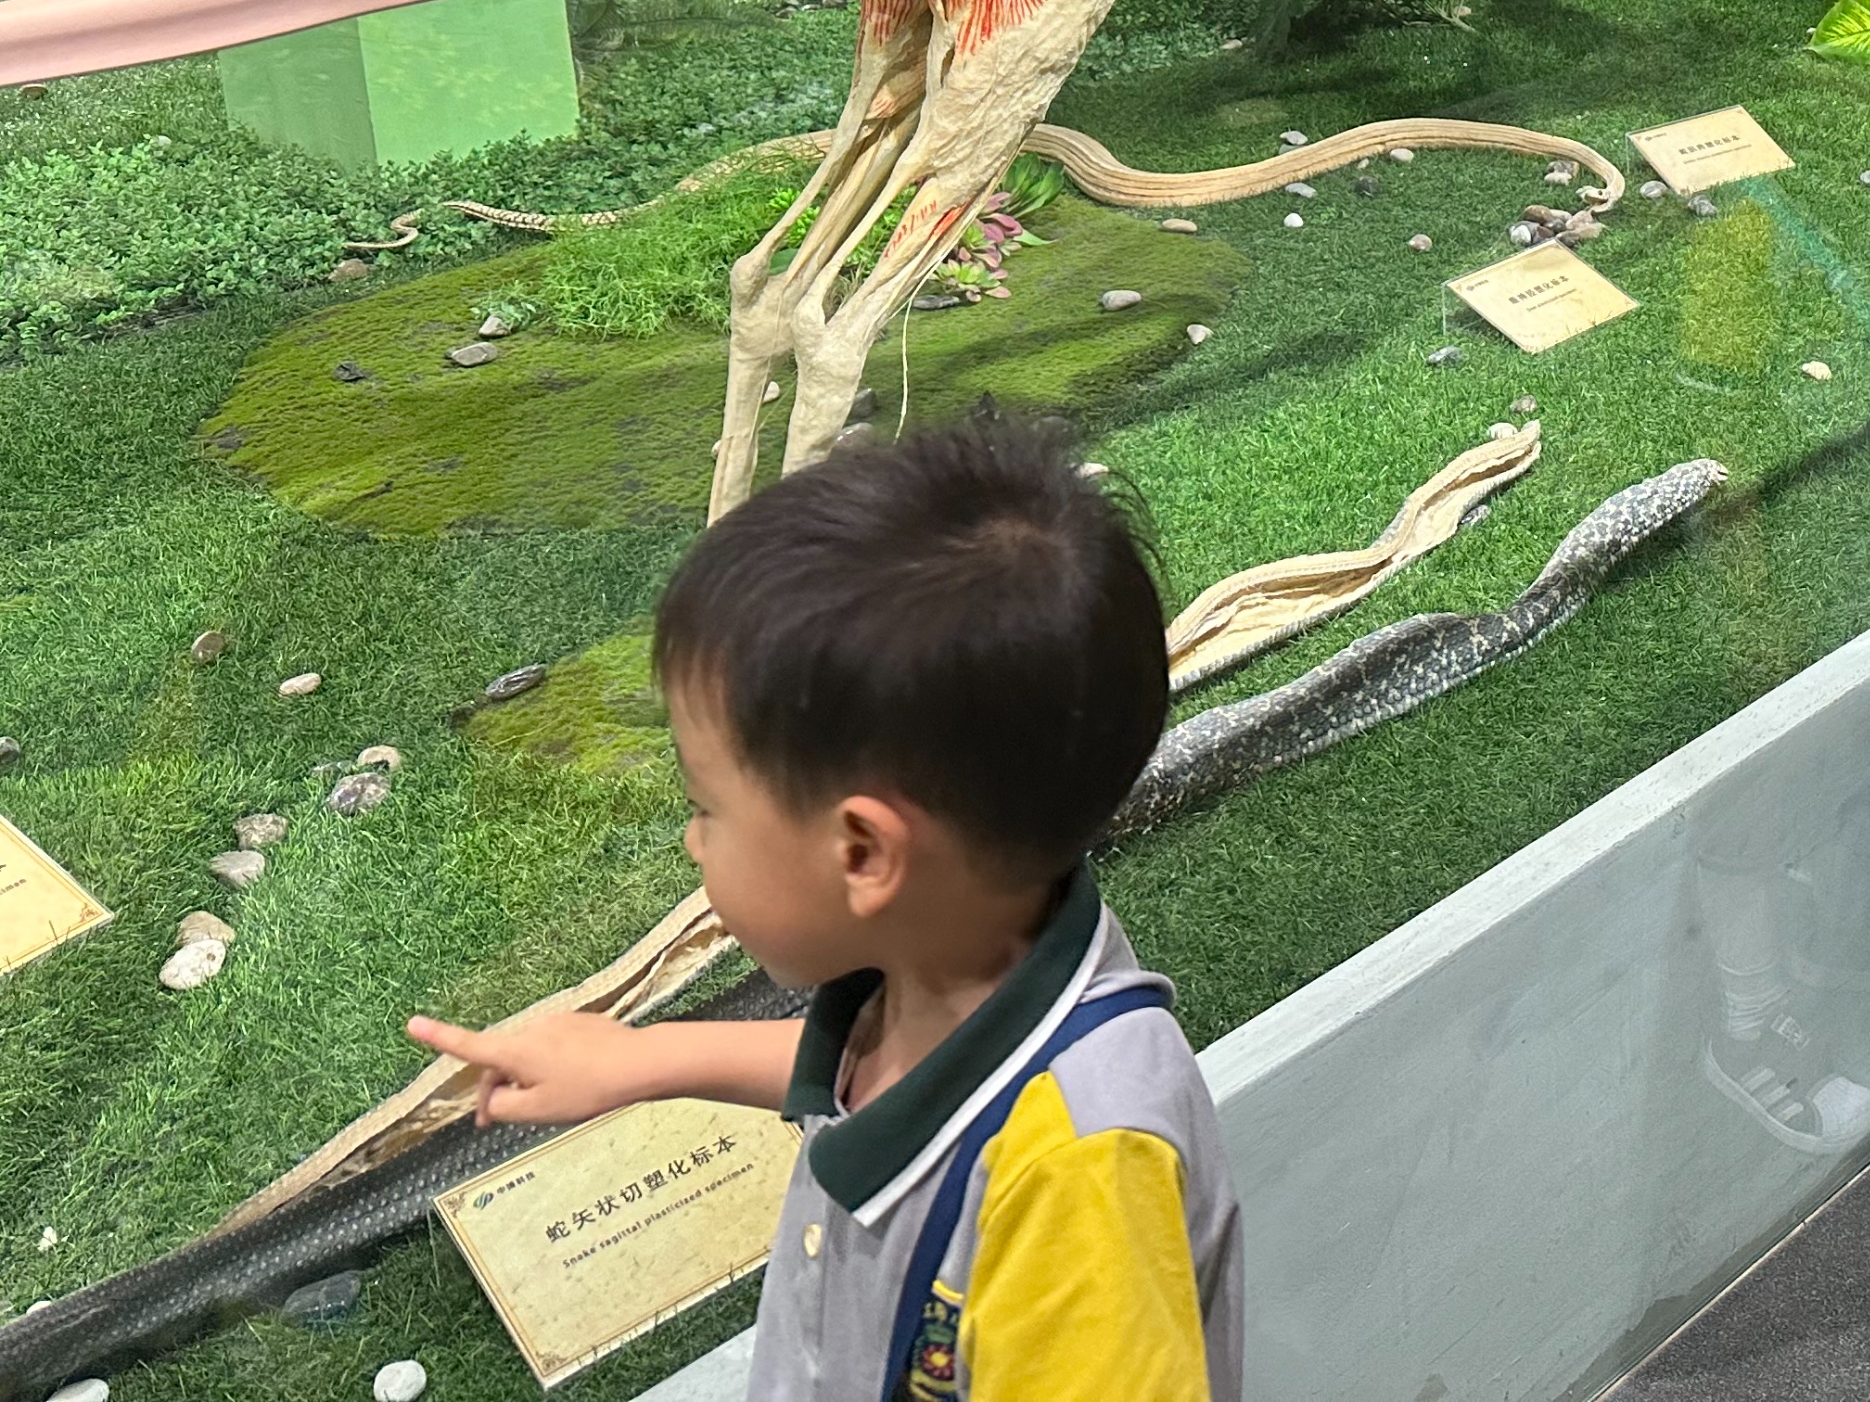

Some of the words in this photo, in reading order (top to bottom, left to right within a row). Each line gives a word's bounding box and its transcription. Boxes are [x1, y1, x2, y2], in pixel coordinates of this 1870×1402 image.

[545, 1135, 737, 1243] 蛇矢状切塑化标本
[562, 1246, 597, 1269] Snake
[599, 1220, 642, 1249] sagittal
[644, 1189, 702, 1227] plasticized
[704, 1162, 754, 1193] specimen
